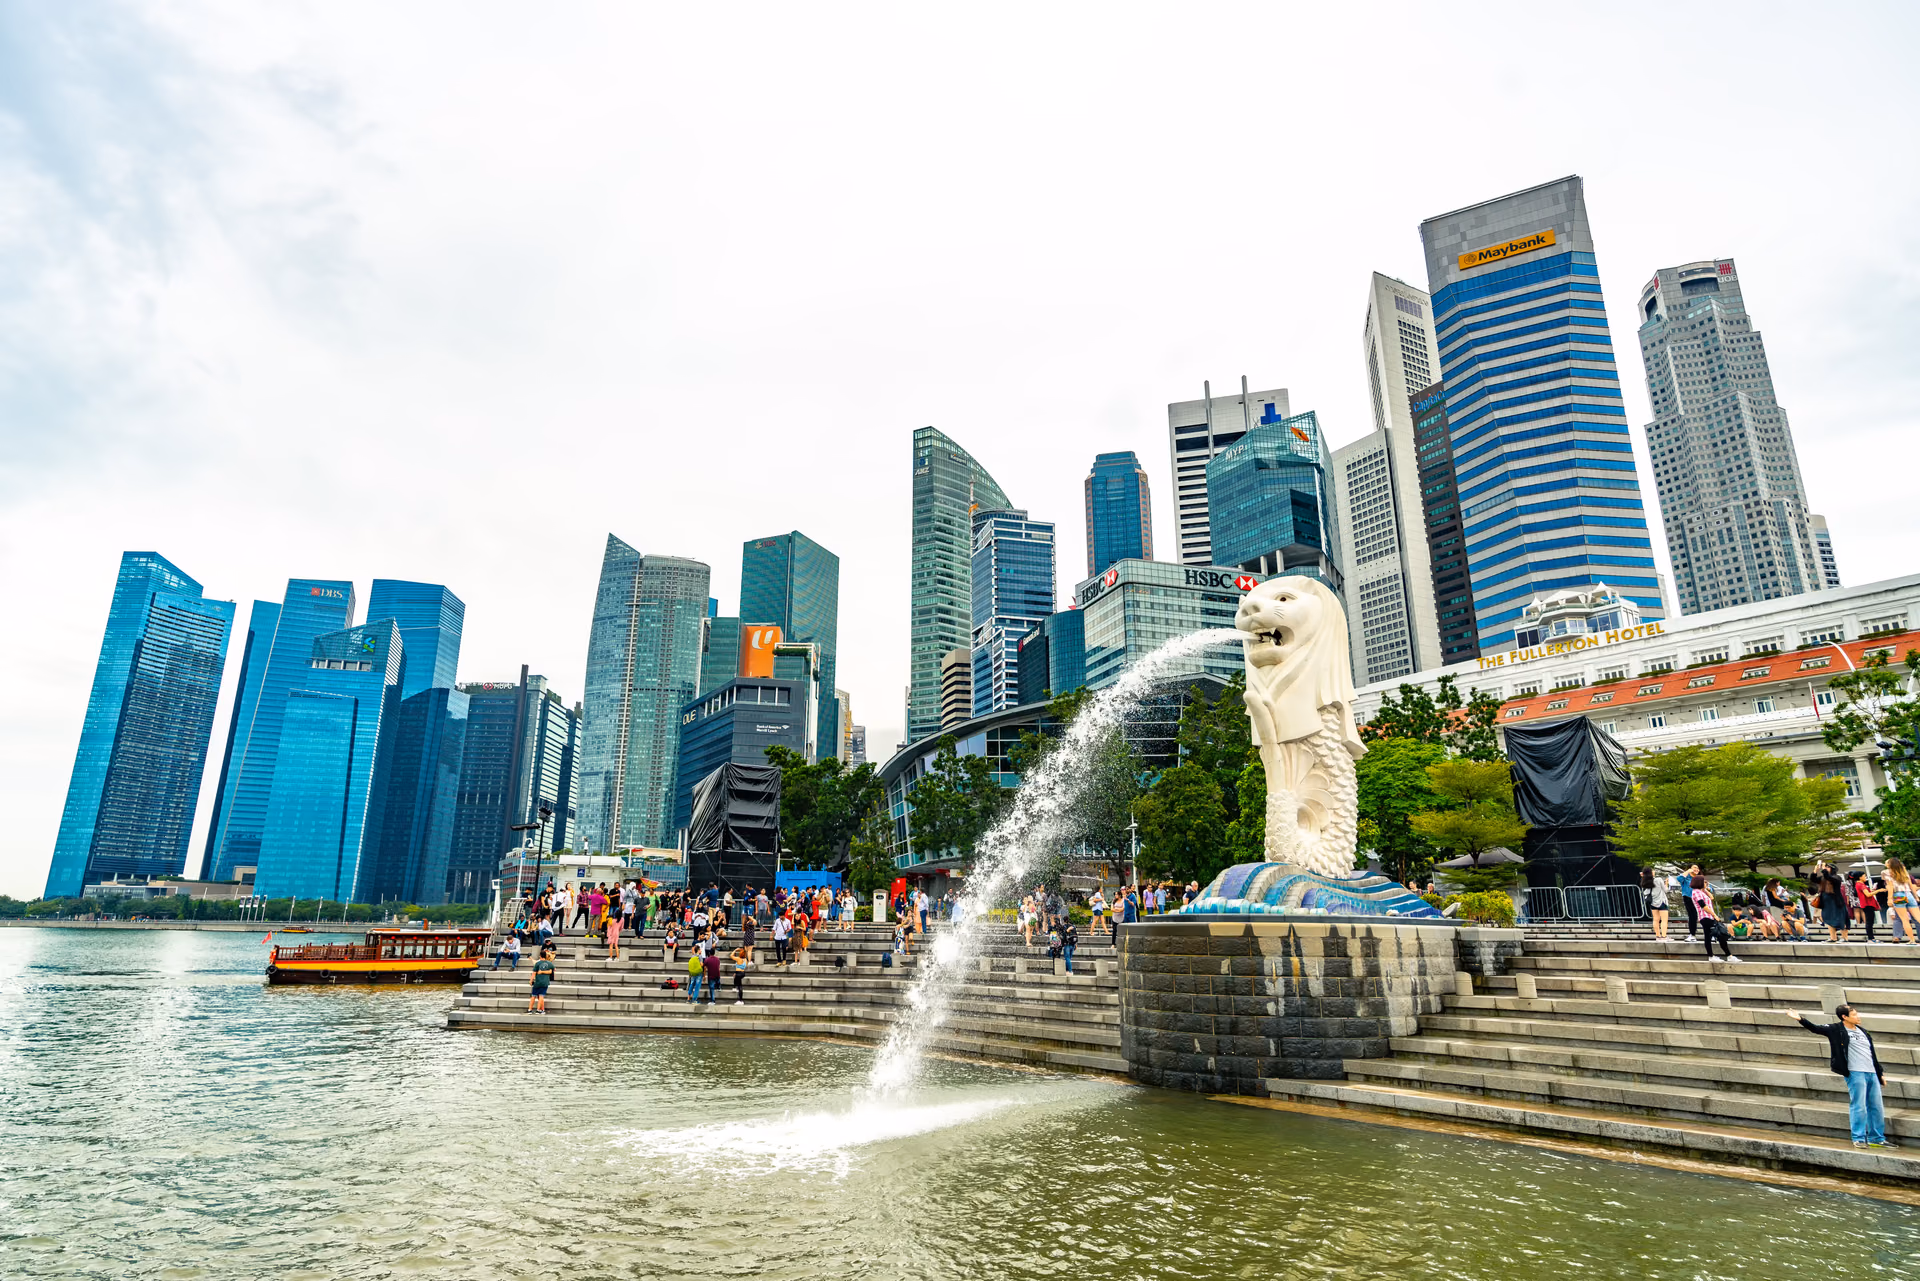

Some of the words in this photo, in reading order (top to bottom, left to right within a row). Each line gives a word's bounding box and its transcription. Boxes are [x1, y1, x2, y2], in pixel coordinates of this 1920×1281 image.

[1478, 235, 1546, 261] Maybank
[1717, 275, 1738, 283] UOB
[1225, 444, 1244, 460] MYP
[1184, 569, 1232, 589] HSBC
[321, 588, 343, 599] DBS
[1081, 576, 1105, 605] HSBC
[1476, 655, 1504, 669] THE
[1510, 634, 1598, 664] FULLERTON
[1606, 622, 1665, 644] HOTEL
[682, 709, 697, 726] OUE
